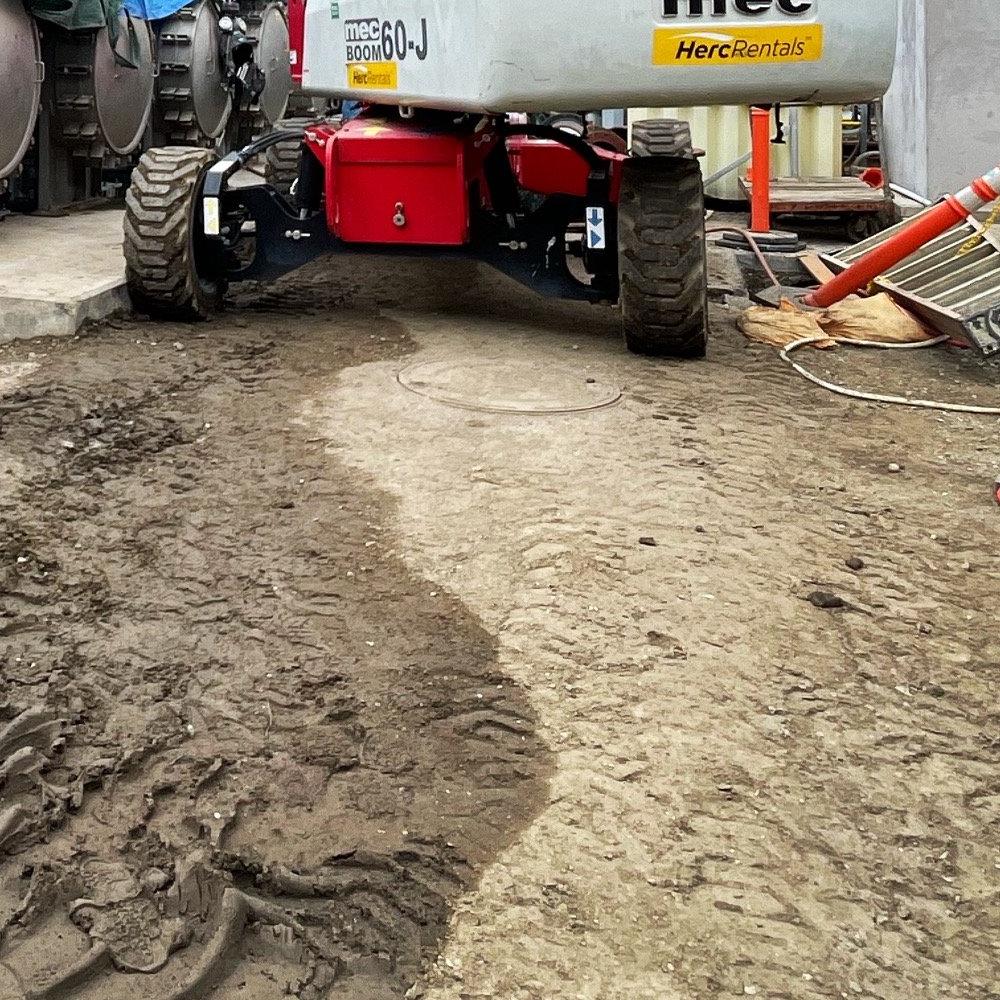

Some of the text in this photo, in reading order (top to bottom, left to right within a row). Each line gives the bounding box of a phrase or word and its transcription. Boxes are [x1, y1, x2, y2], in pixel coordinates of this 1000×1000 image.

[345, 20, 380, 40] mec
[381, 18, 428, 61] 60-J
[346, 45, 382, 61] BOOM
